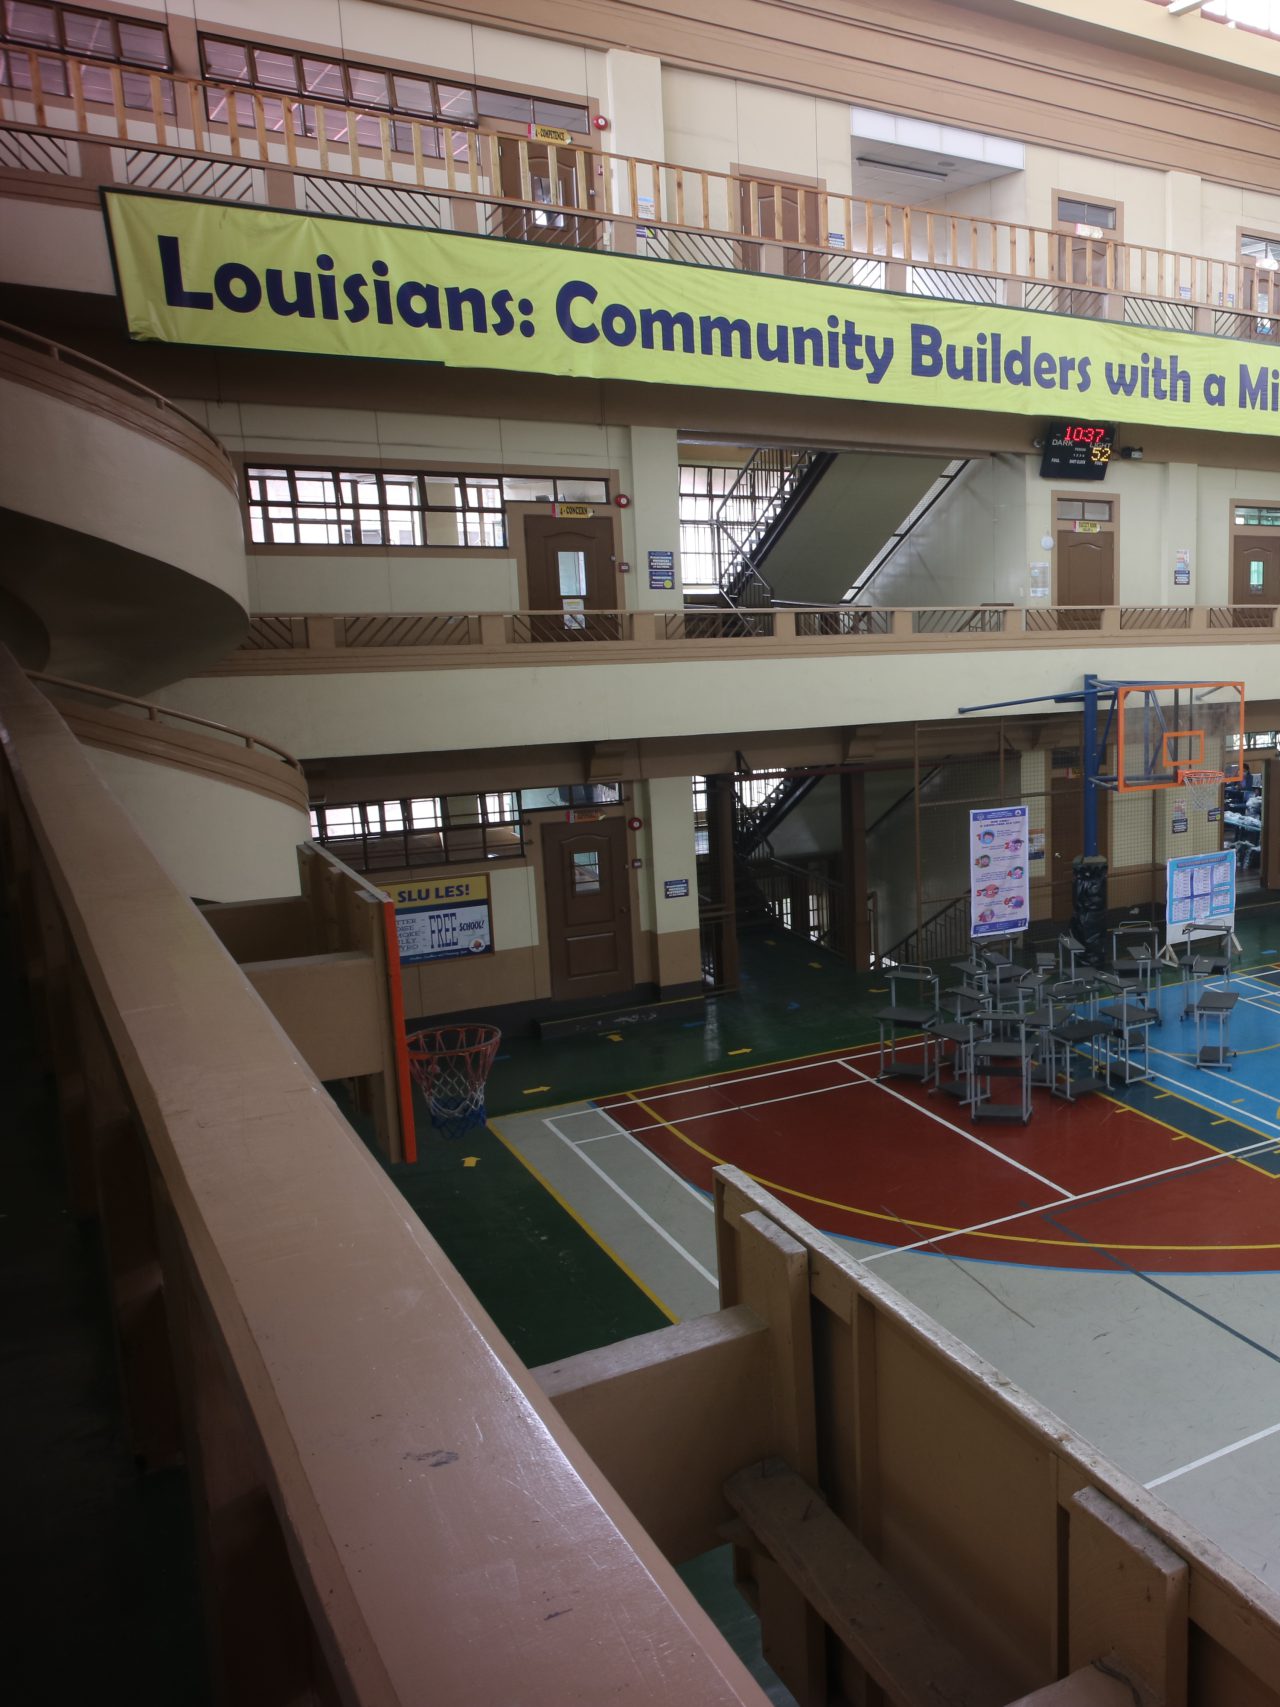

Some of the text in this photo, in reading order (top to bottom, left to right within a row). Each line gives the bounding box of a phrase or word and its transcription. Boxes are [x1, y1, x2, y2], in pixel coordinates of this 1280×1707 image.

[157, 235, 535, 338] Louisians:
[555, 280, 894, 385] Community
[910, 323, 1092, 393] Builders
[1104, 353, 1191, 404] with
[1203, 374, 1226, 407] a
[1052, 439, 1074, 447] DARK
[1091, 447, 1111, 462] 52
[566, 506, 588, 515] CONCERN
[397, 884, 470, 903] SLU LES!
[428, 912, 459, 949] FREE
[459, 920, 485, 932] SCHOOL!
